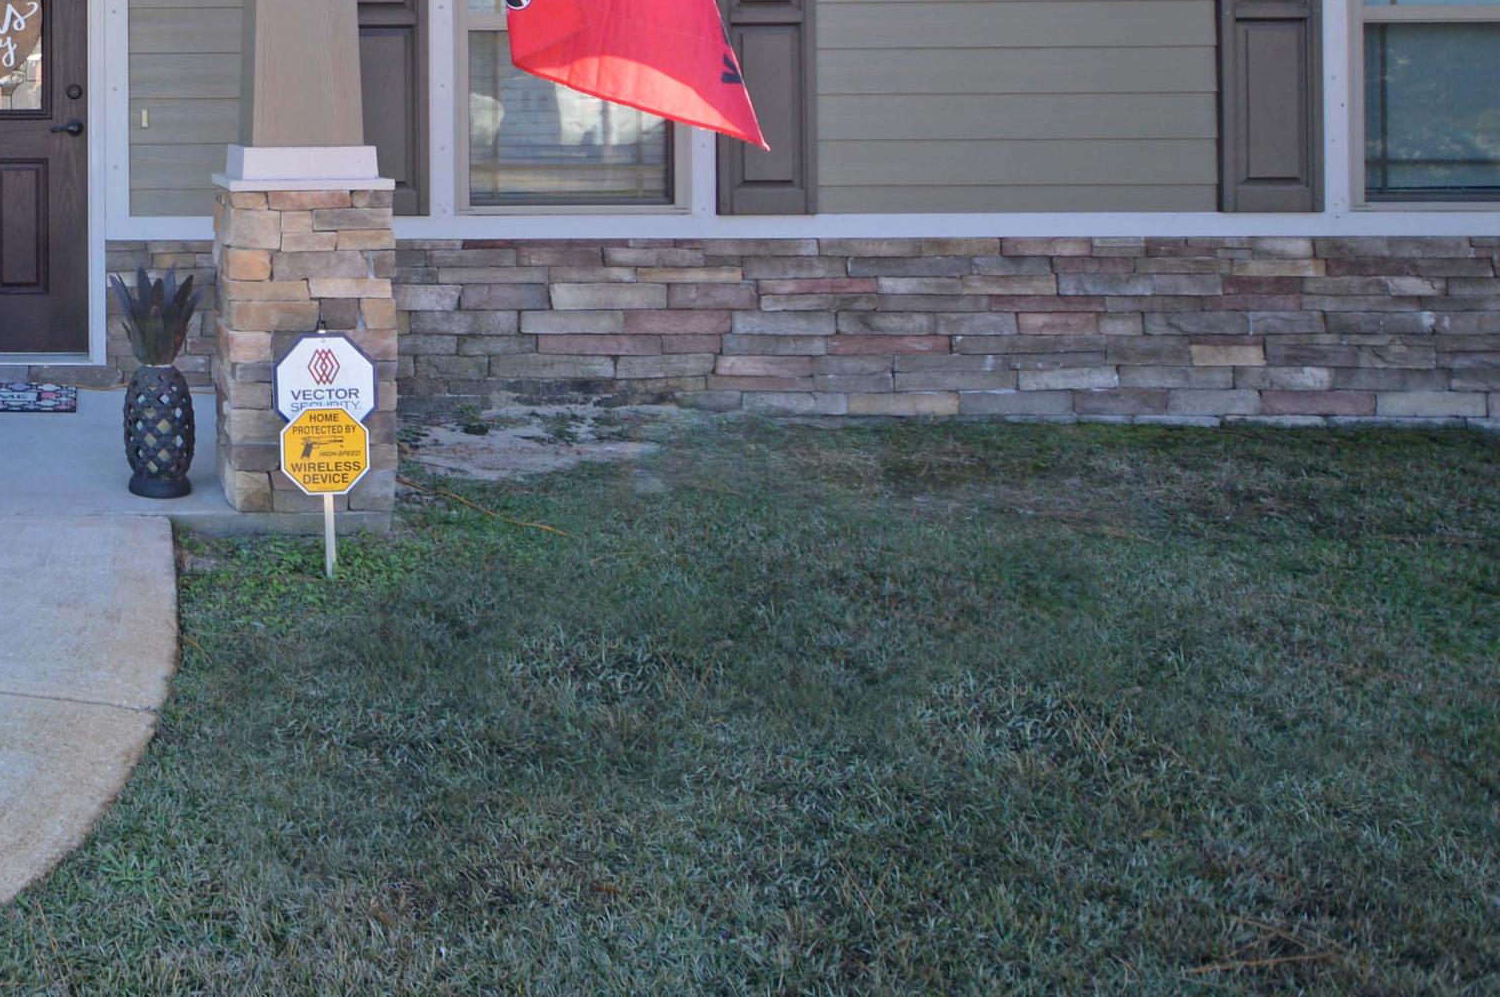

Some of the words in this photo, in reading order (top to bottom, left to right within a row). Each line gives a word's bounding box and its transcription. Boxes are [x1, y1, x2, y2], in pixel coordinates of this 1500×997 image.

[291, 388, 359, 400] VECTOR
[309, 413, 340, 422] HOME
[292, 425, 343, 434] PROTECTED
[345, 425, 356, 433] BY
[290, 461, 361, 473] WIRELESS
[302, 473, 349, 484] DEVICE
